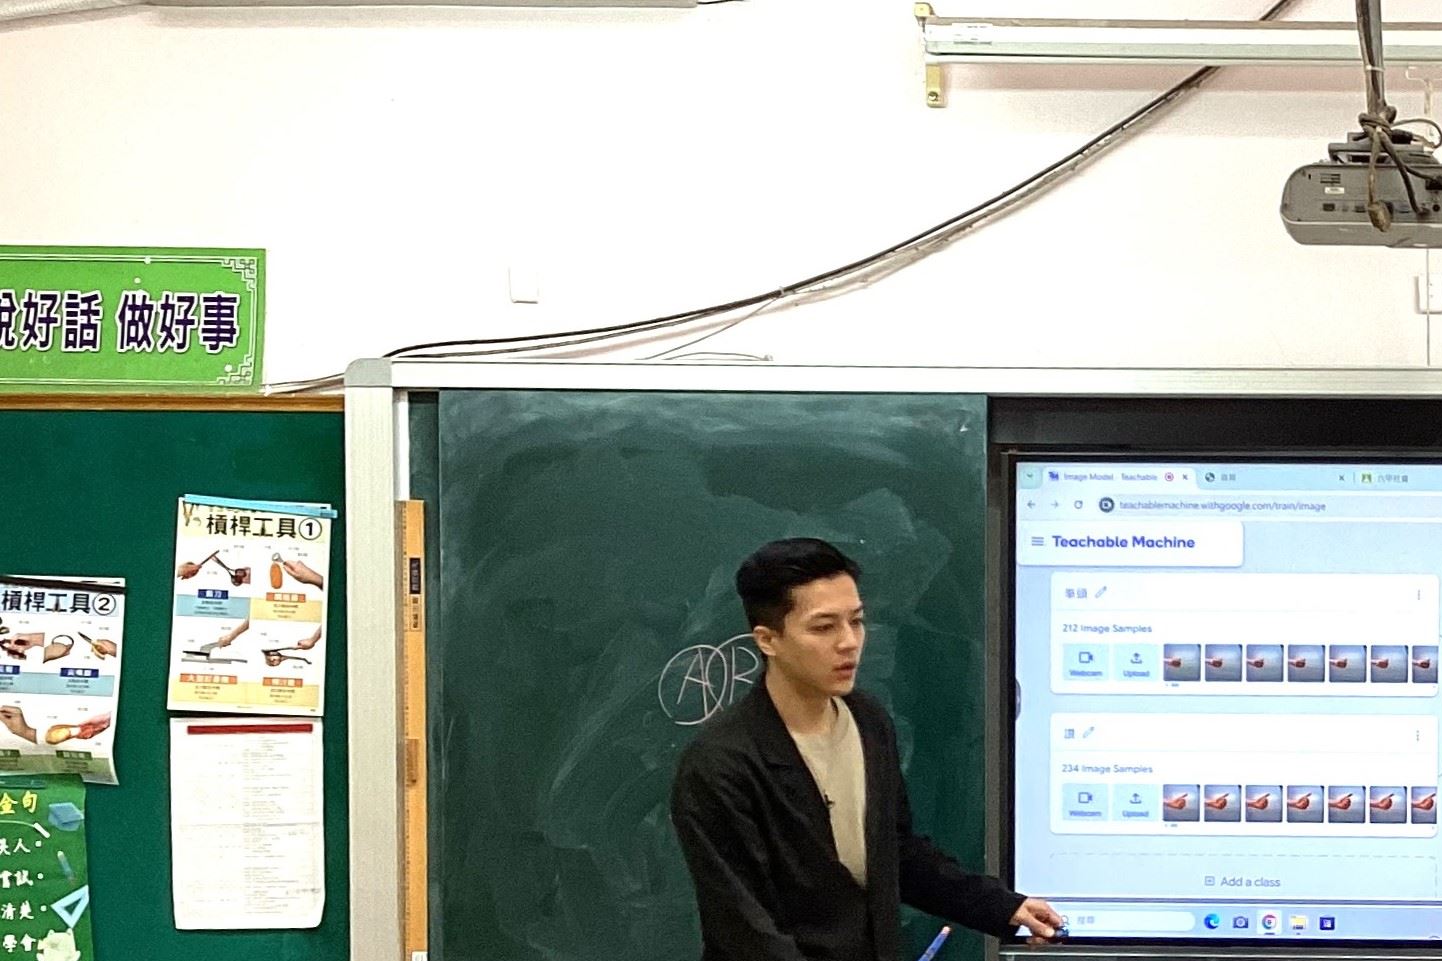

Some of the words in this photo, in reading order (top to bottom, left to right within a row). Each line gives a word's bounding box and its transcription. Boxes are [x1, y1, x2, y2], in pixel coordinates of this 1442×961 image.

[117, 291, 239, 352] 做好事
[1052, 535, 1129, 549] Teachable
[1132, 535, 1196, 549] Machine
[1062, 623, 1078, 633] 212
[1080, 624, 1110, 634] Image
[1112, 624, 1153, 634] Samples
[1062, 763, 1079, 773] 234
[1081, 764, 1111, 775] Image
[1113, 764, 1154, 774] Samples
[1220, 876, 1244, 888] Add
[1245, 879, 1252, 888] a
[1254, 876, 1281, 888] class
